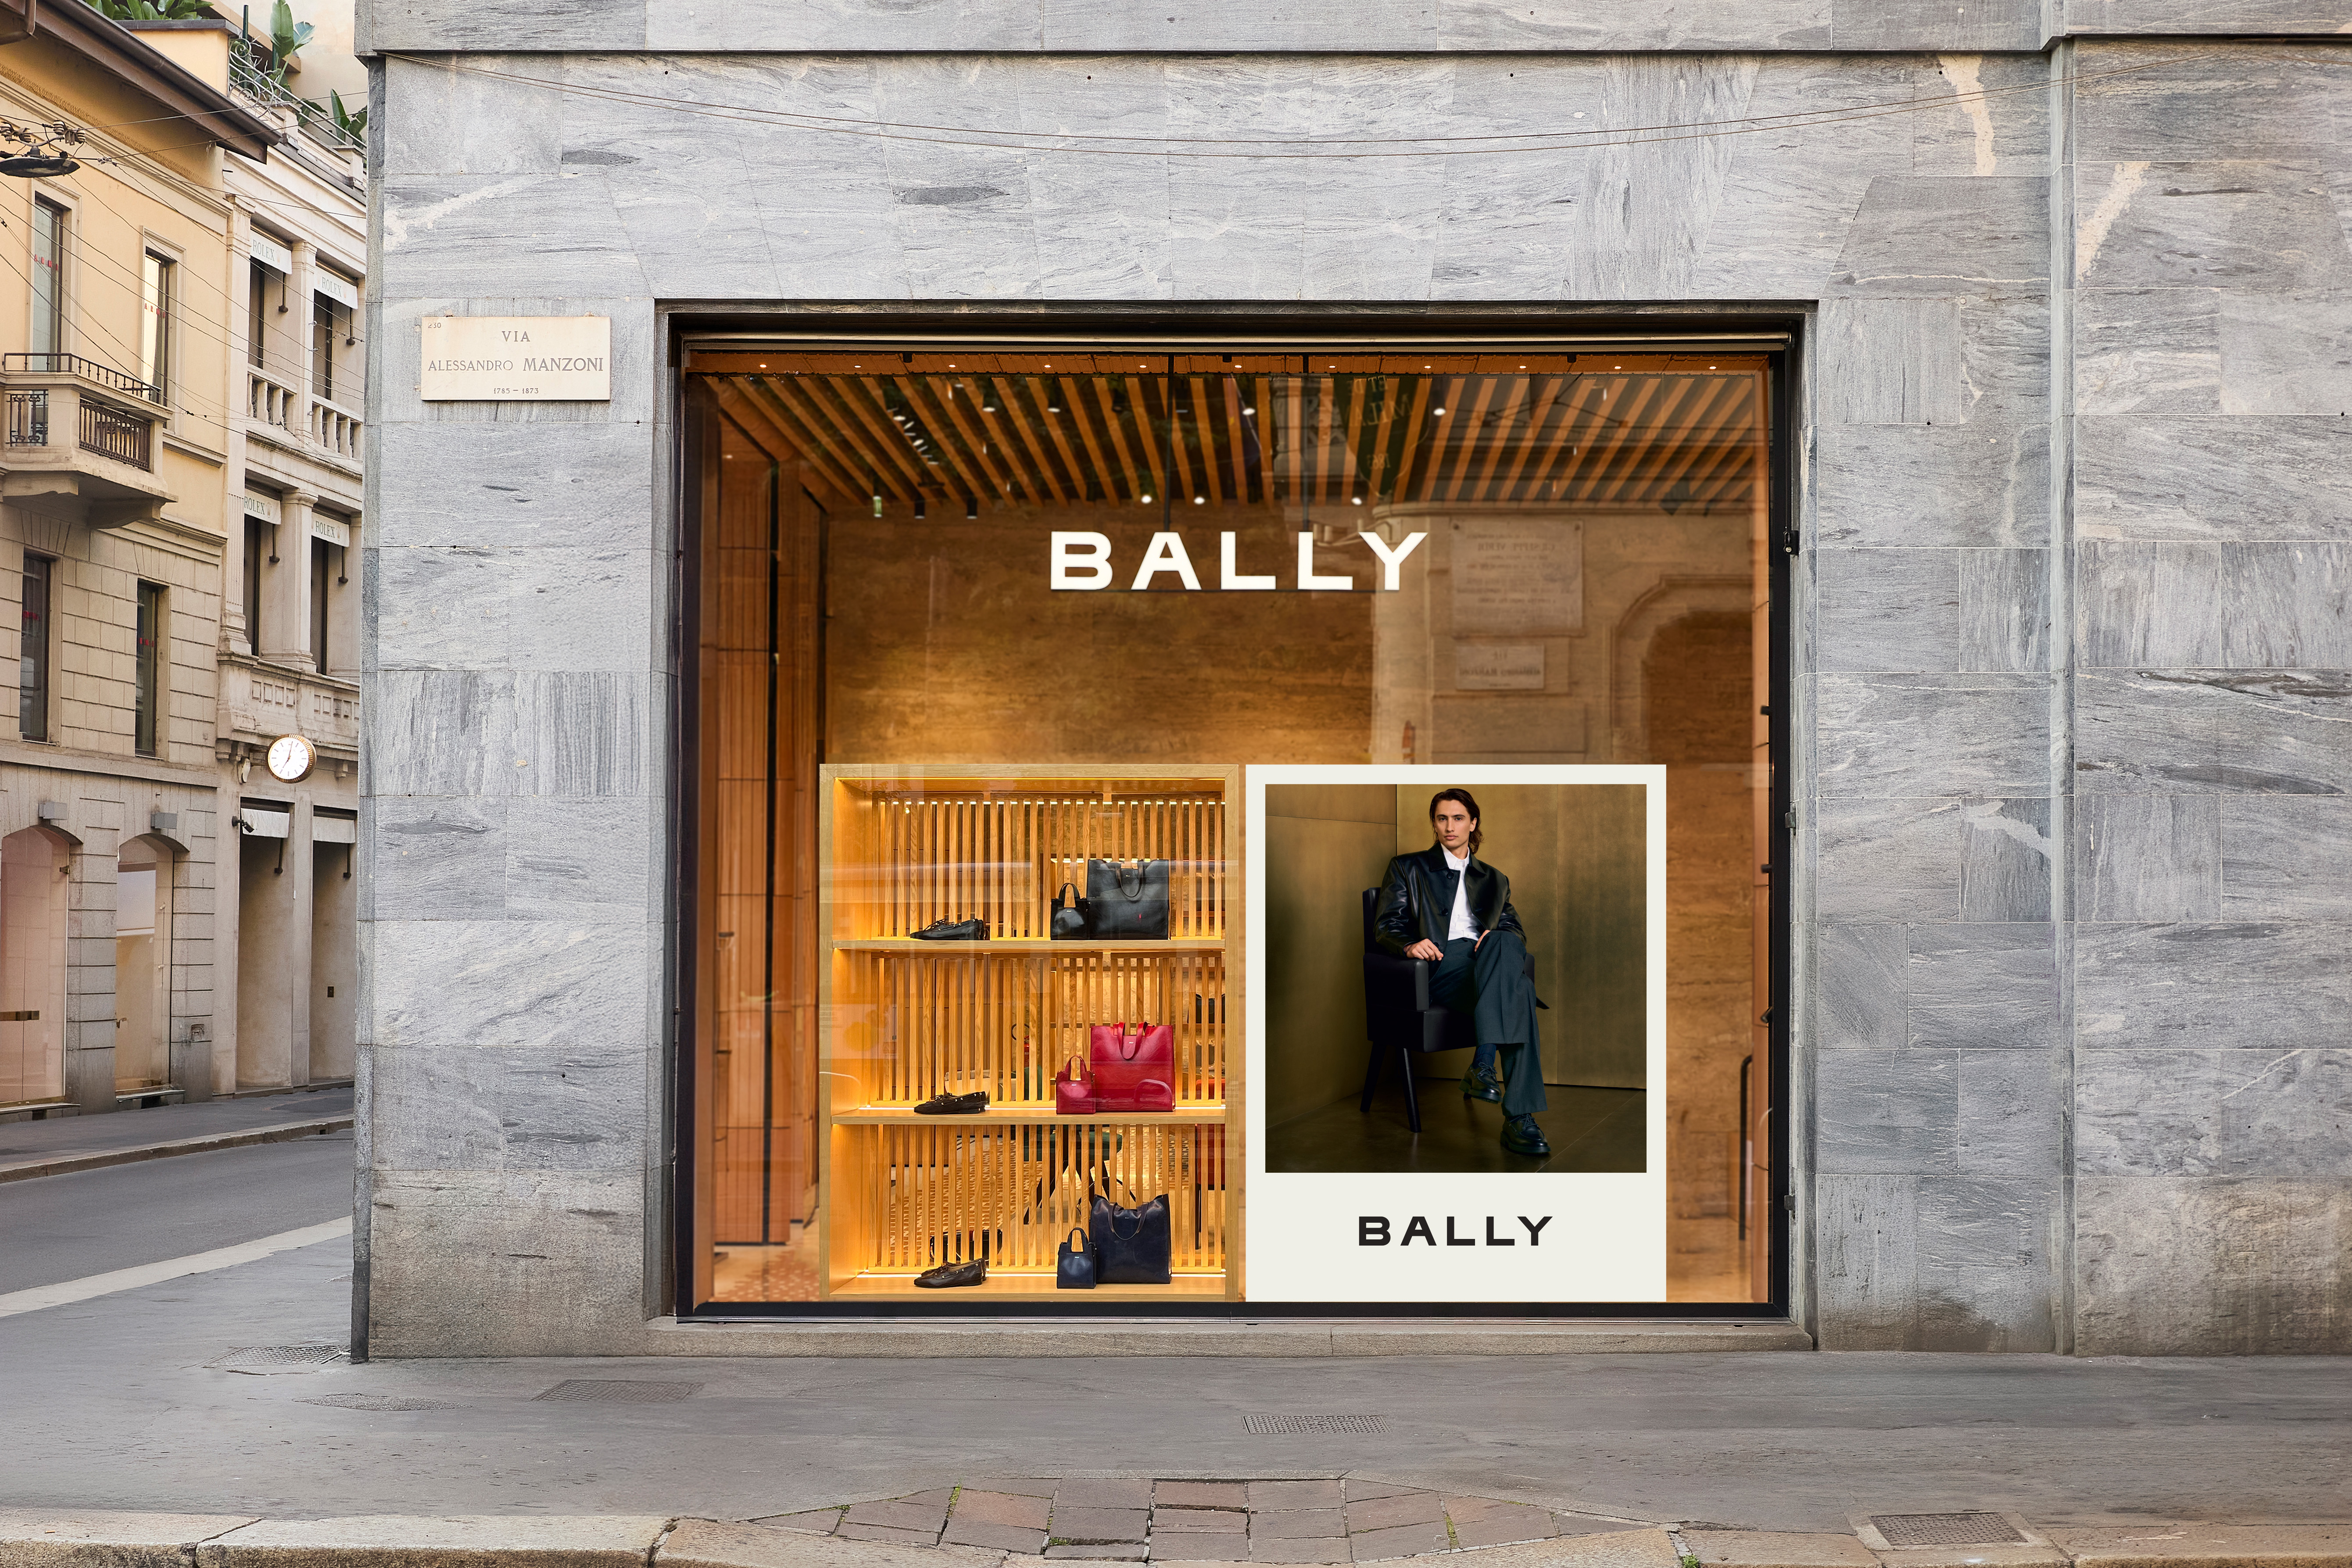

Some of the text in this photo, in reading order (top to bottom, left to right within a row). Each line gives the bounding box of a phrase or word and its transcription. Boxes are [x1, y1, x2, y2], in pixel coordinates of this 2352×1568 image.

[253, 239, 275, 261] ROLEX
[322, 276, 342, 297] ROLEX
[501, 331, 530, 342] VIA
[428, 358, 604, 372] ALESSANDRO MANZONI
[244, 496, 265, 516] ROLEX
[315, 520, 335, 538] ROLEX
[1050, 531, 1428, 591] BALLY
[1359, 1216, 1553, 1246] BALLY
